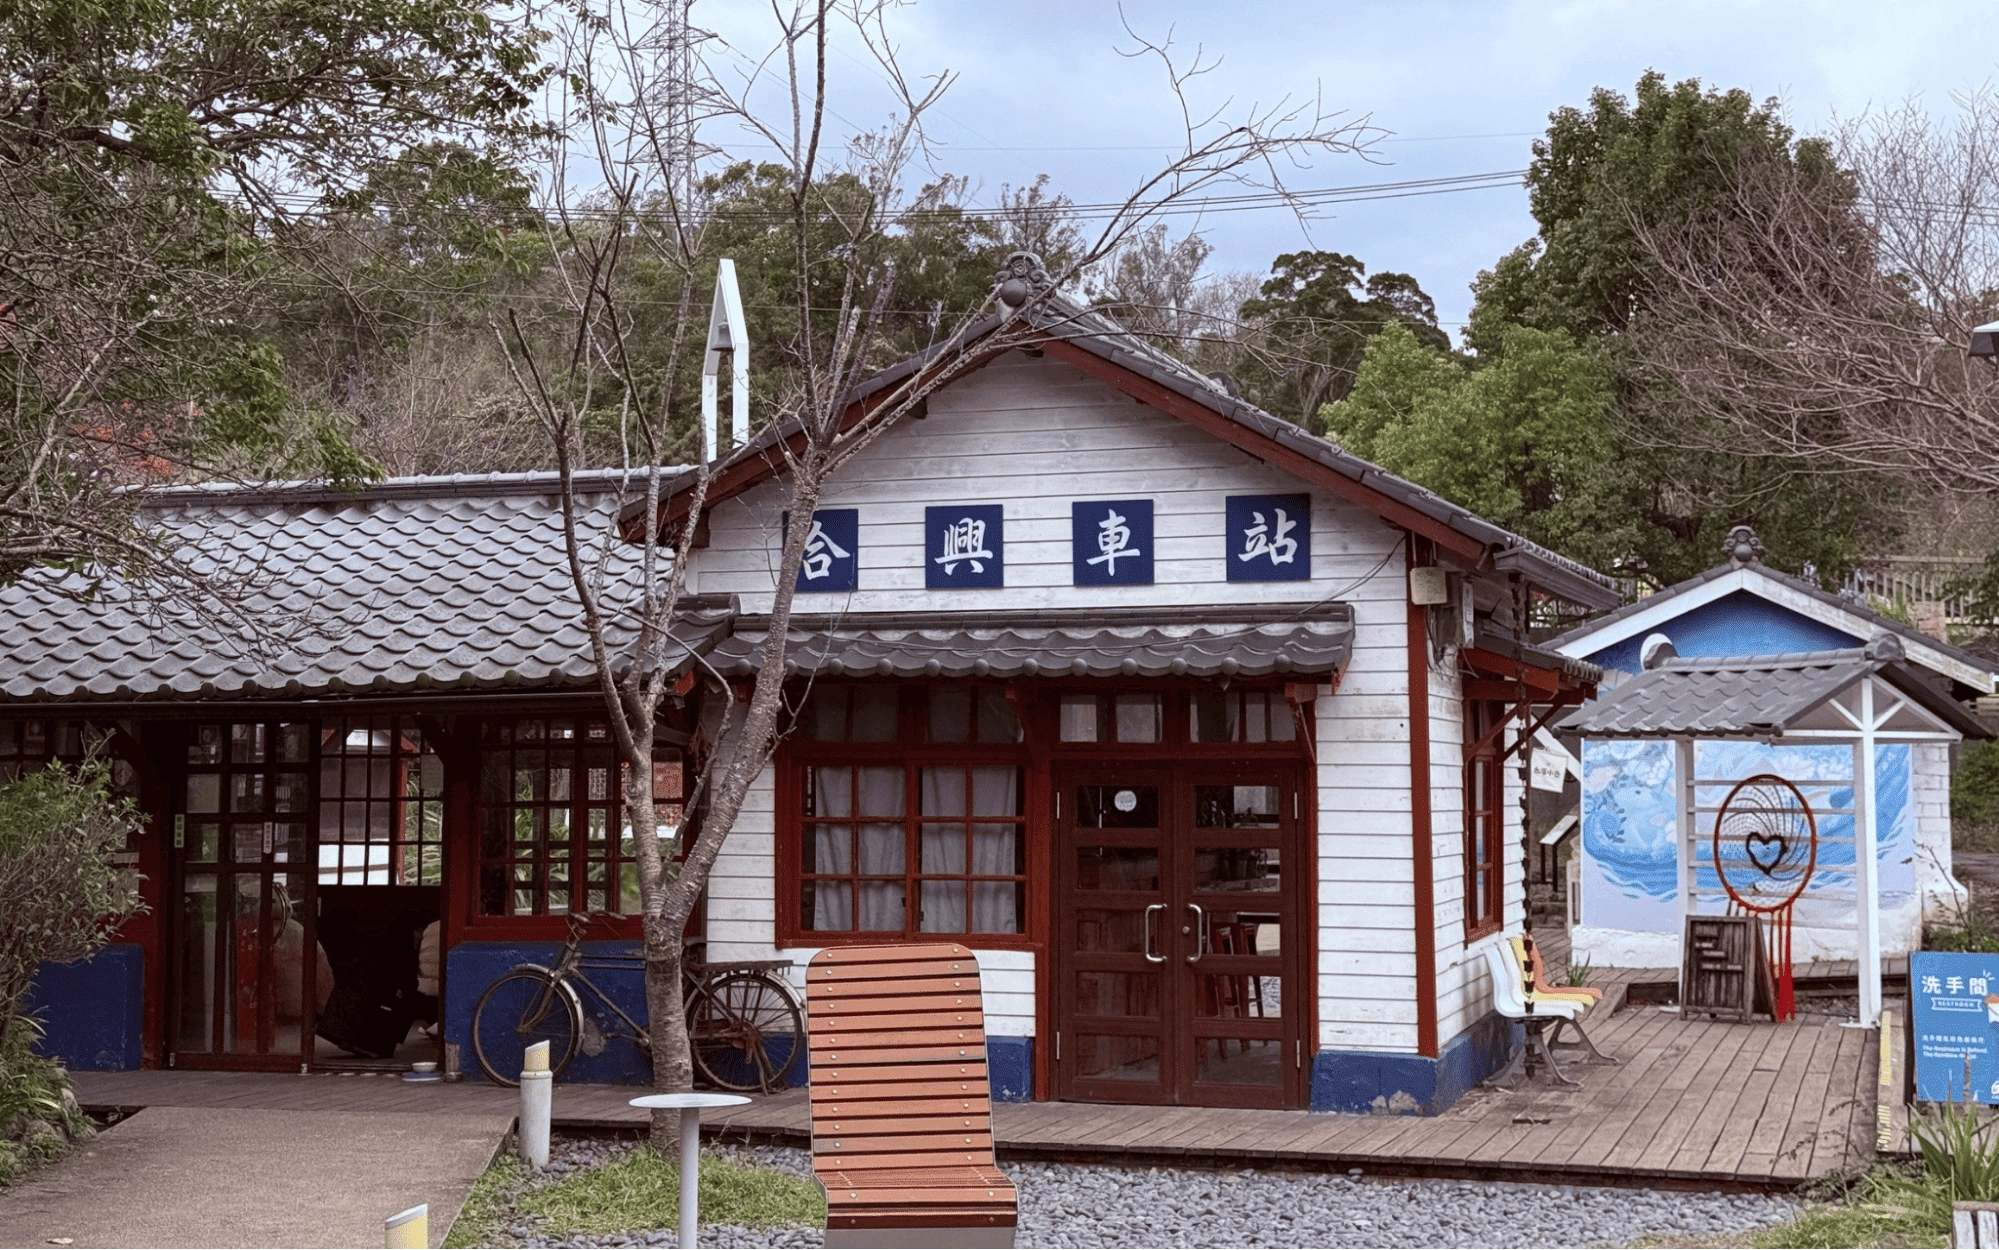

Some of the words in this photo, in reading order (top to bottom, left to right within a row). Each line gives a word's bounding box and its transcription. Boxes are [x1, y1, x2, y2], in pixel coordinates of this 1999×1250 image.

[1921, 975, 1988, 996] 洗手間
[1937, 1000, 1975, 1008] RESTROOM
